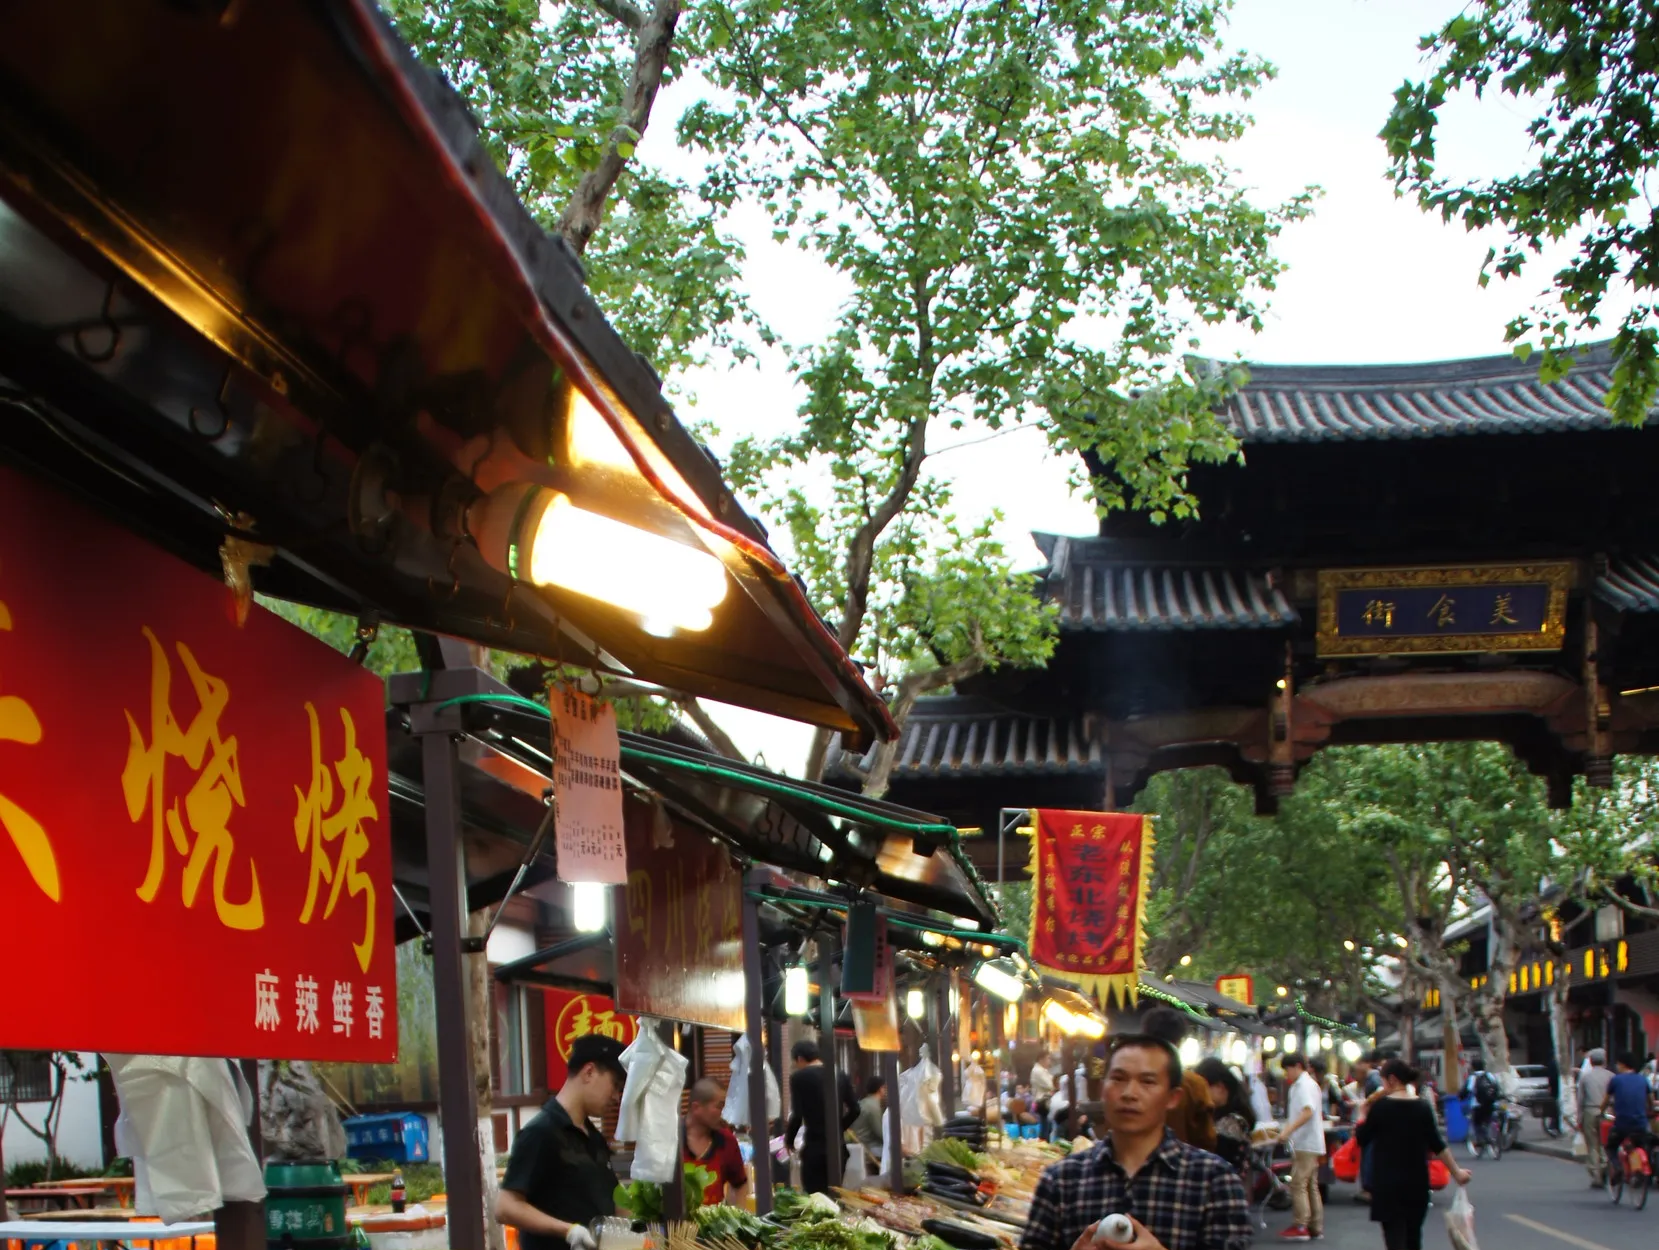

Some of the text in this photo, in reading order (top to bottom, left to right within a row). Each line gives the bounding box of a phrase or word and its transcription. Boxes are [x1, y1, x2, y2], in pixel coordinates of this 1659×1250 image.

[0, 598, 378, 973] 烧烤
[1070, 824, 1107, 840] 正宗
[254, 967, 384, 1039] 麻辣鲜香
